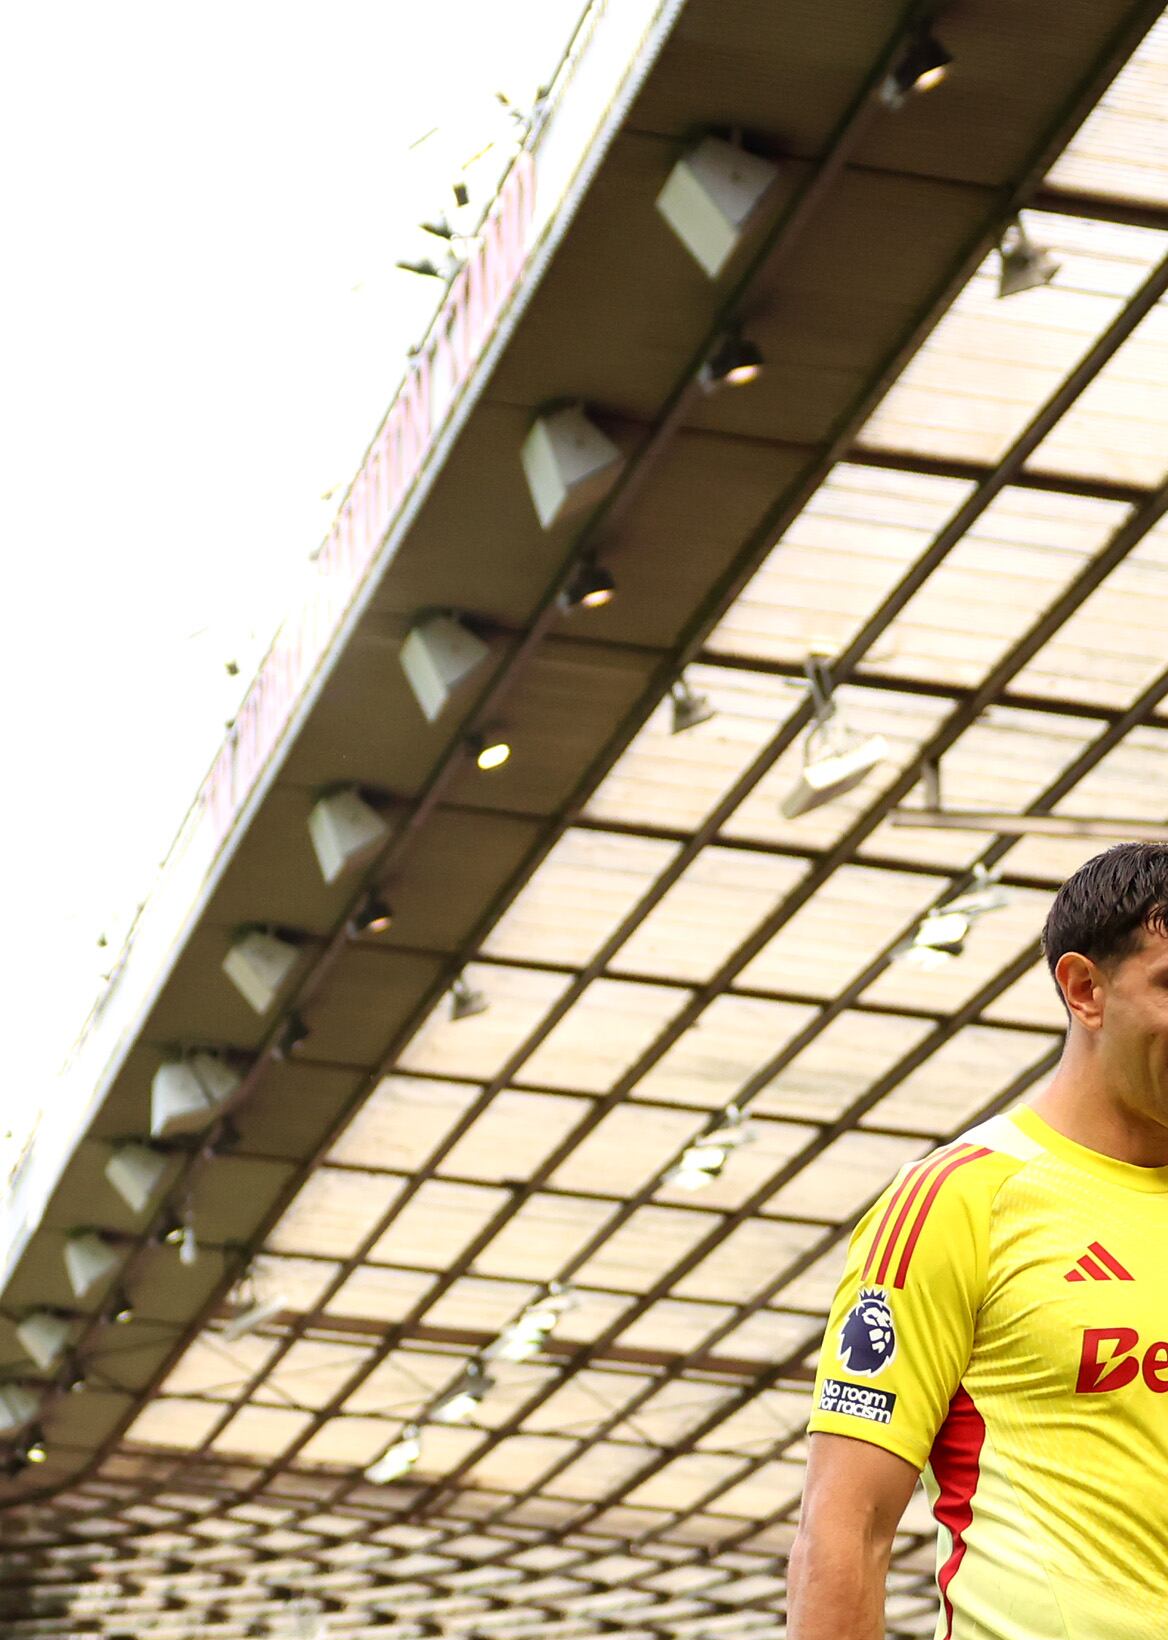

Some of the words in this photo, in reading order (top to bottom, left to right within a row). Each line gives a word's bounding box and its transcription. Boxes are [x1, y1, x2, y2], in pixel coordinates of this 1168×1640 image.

[822, 1379, 841, 1398] No
[841, 1386, 887, 1408] room
[836, 1399, 892, 1423] racism
